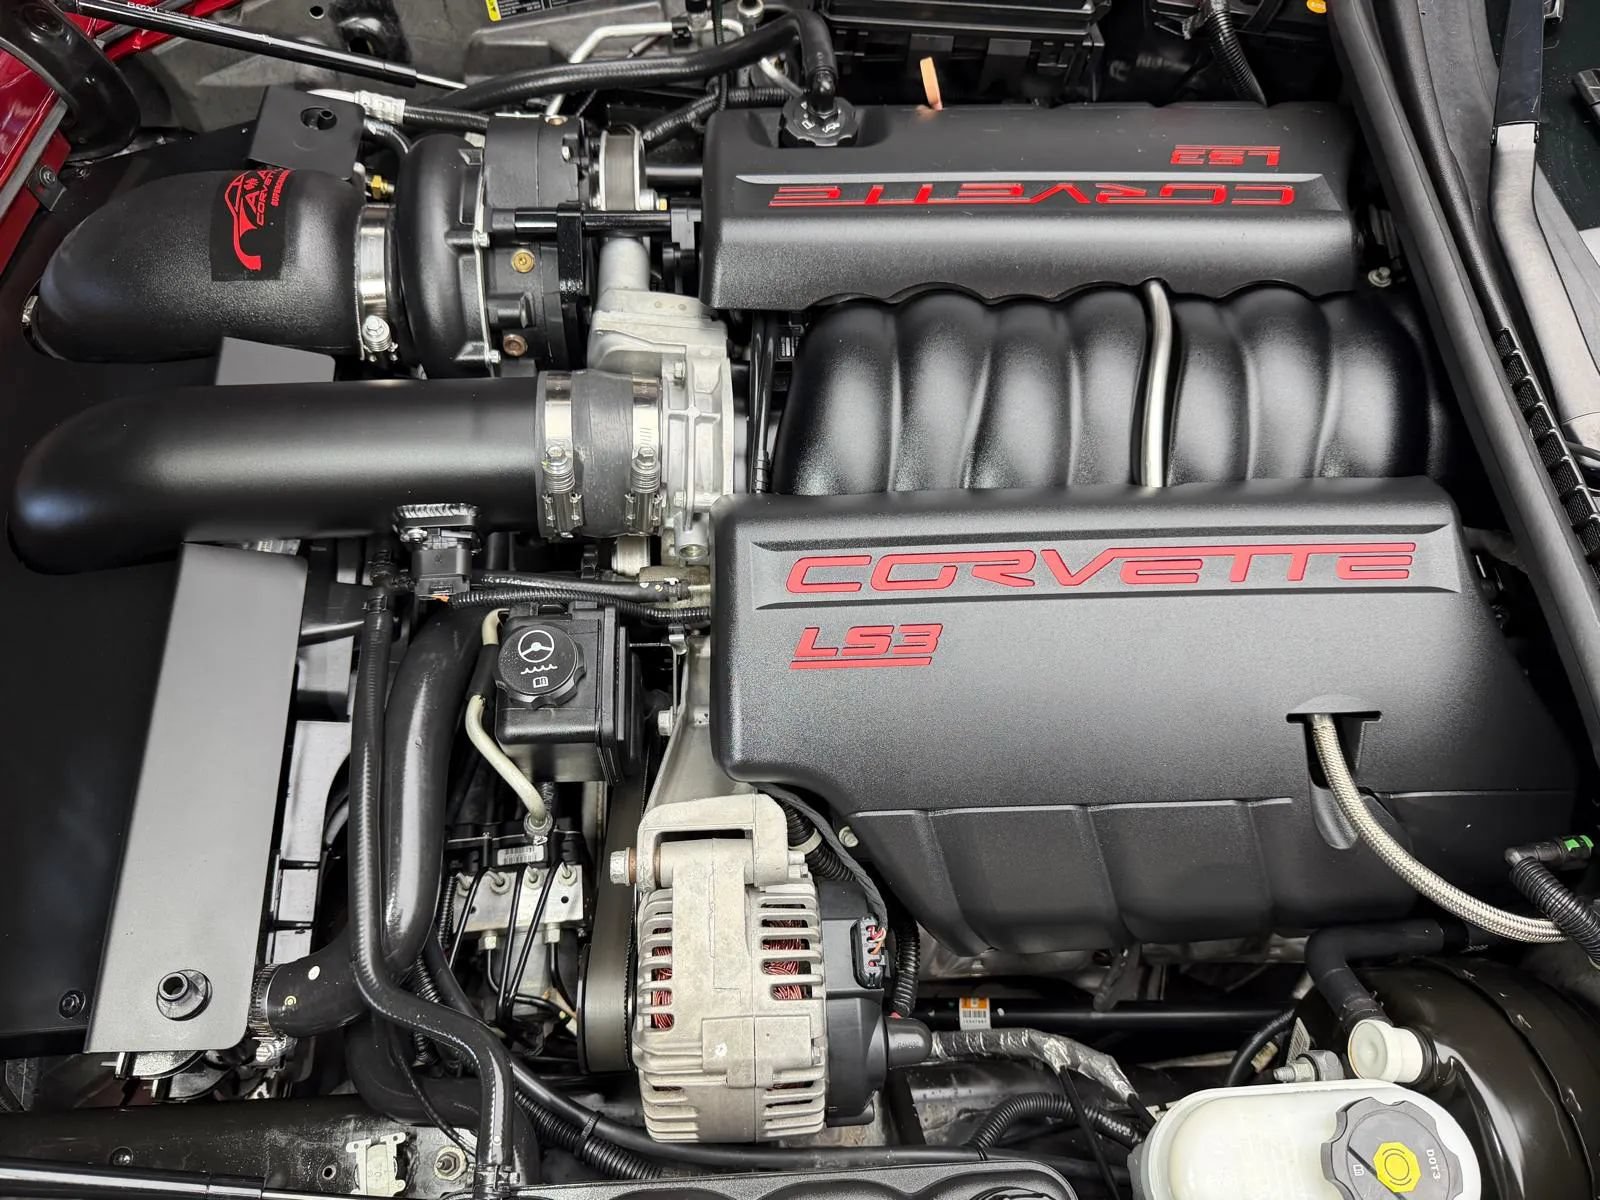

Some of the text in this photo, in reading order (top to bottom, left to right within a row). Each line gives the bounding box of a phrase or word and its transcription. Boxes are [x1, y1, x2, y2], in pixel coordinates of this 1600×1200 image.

[1170, 145, 1280, 166] LS3
[768, 183, 1295, 208] CORVETTE
[786, 542, 1416, 594] CORVETTE
[794, 623, 944, 658] LS3
